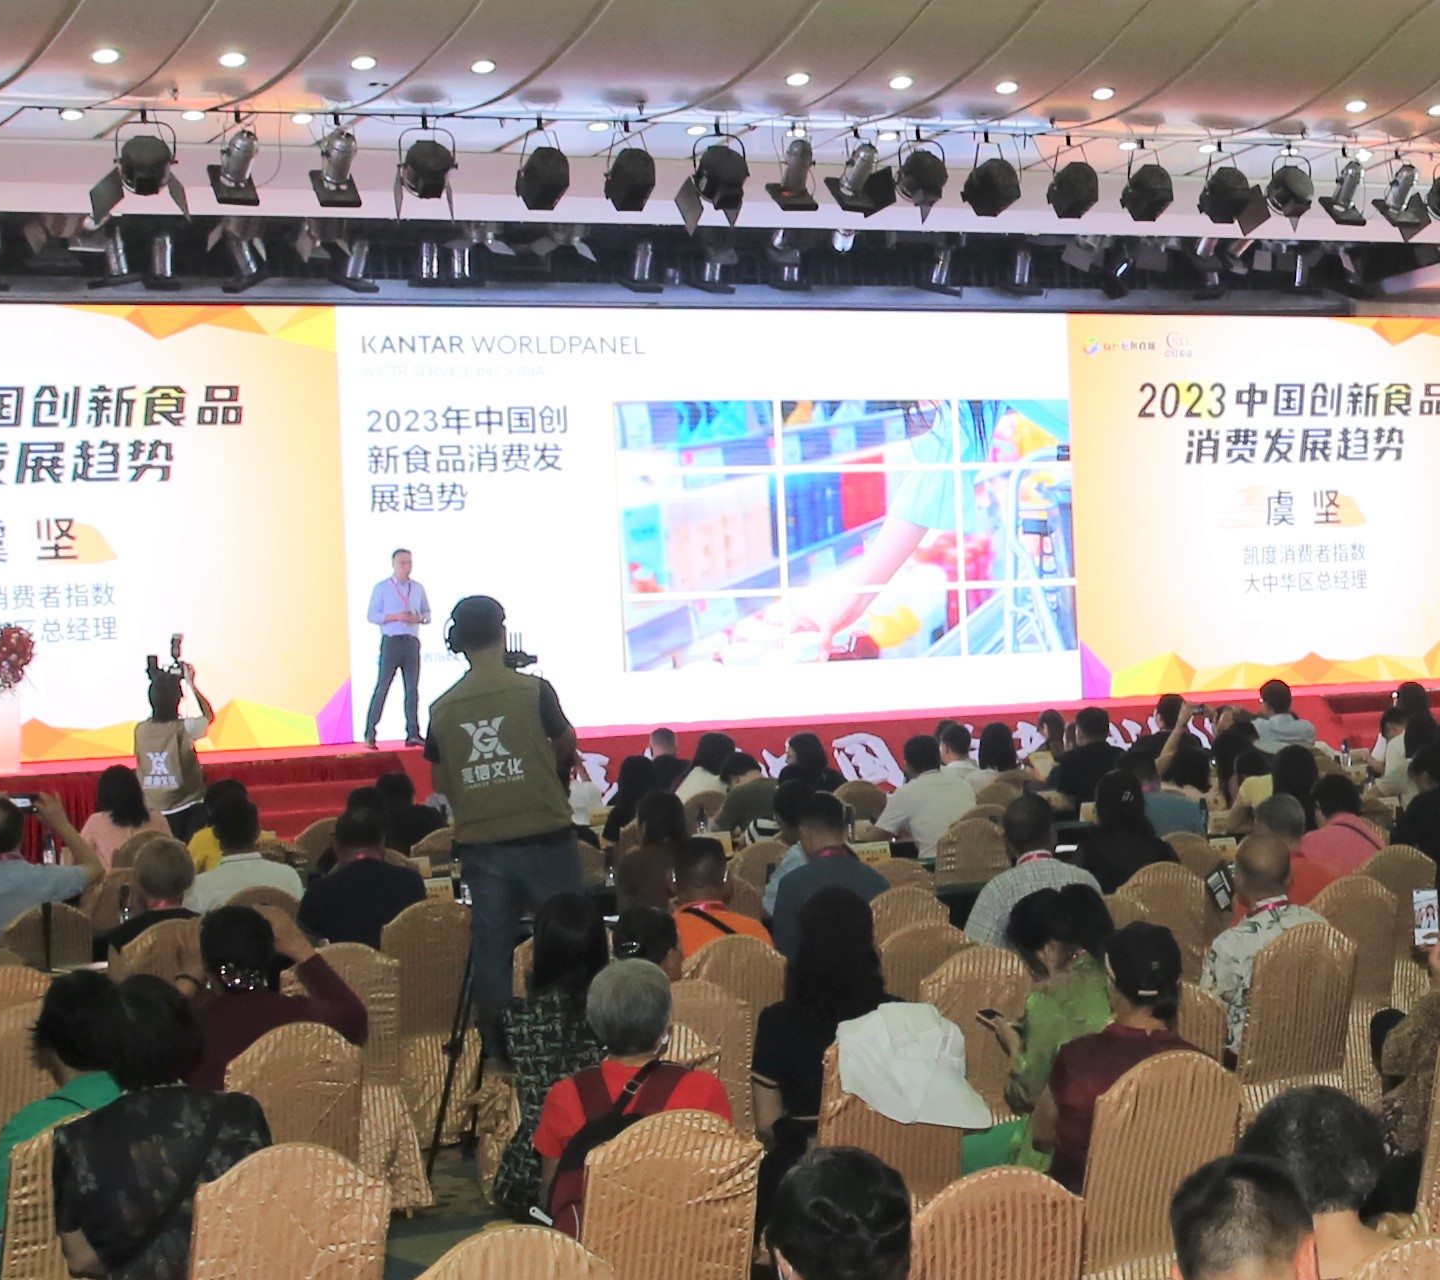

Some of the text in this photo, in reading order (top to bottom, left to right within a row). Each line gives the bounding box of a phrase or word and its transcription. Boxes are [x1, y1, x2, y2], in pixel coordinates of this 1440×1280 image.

[361, 335, 646, 355] KANTAR WORLDPANEL
[413, 365, 472, 378] SERVICE
[476, 365, 492, 378] IN
[497, 365, 546, 378] CHINA
[366, 405, 568, 435] 2023年中国创
[367, 443, 563, 474] 新食品消费发
[1184, 426, 1405, 464] 消费发展趋势
[370, 482, 468, 513] 展趋势
[1243, 543, 1367, 565] 凯度消费者指数
[1244, 569, 1368, 593] 大中华区总经理
